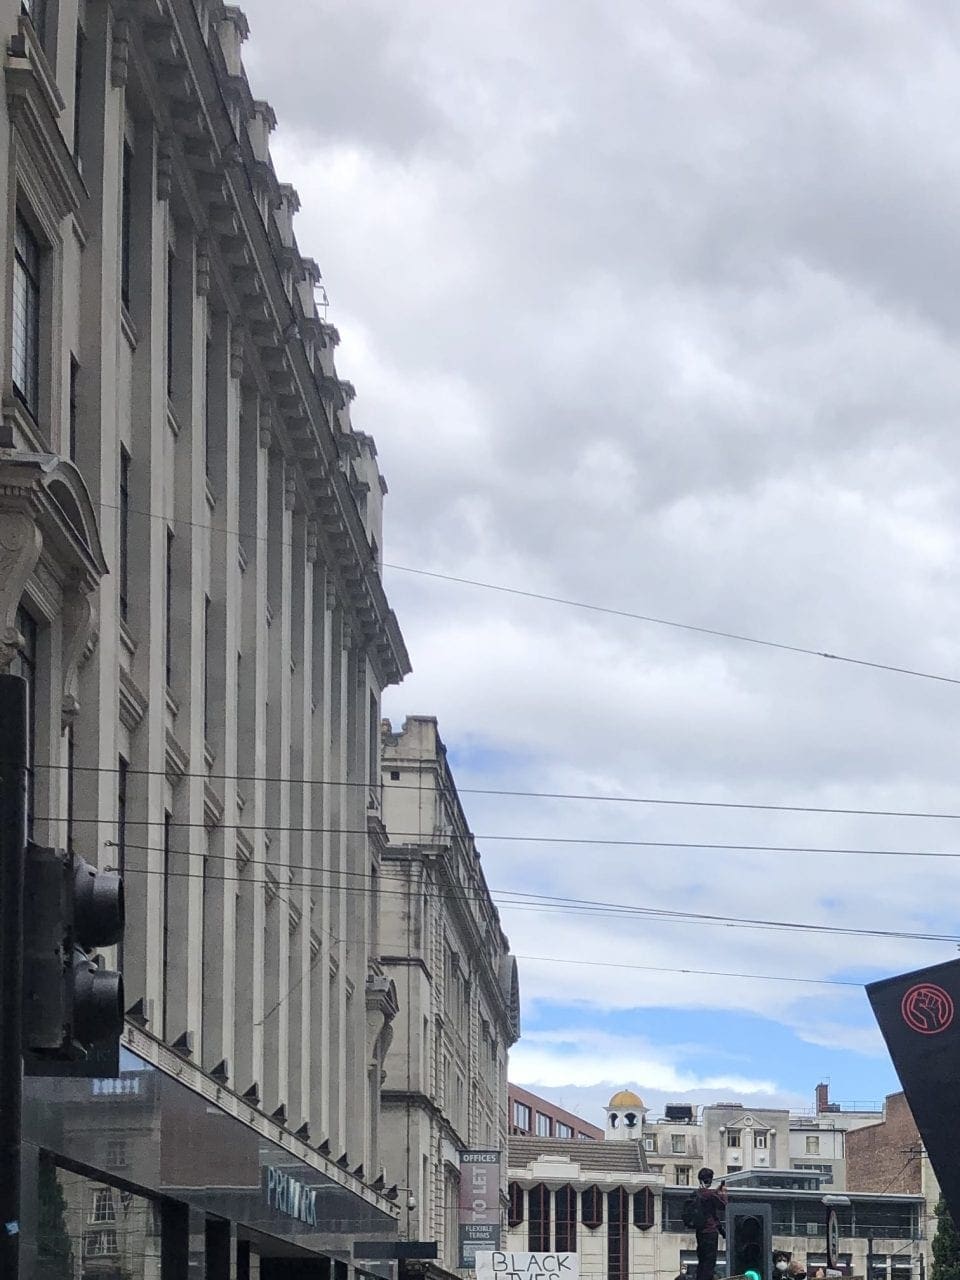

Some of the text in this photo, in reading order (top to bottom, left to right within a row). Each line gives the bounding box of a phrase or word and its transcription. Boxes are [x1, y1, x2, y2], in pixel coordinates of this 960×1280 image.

[463, 1154, 497, 1163] OFFICES
[472, 1165, 487, 1221] TO LET
[492, 1252, 572, 1272] BLACK
